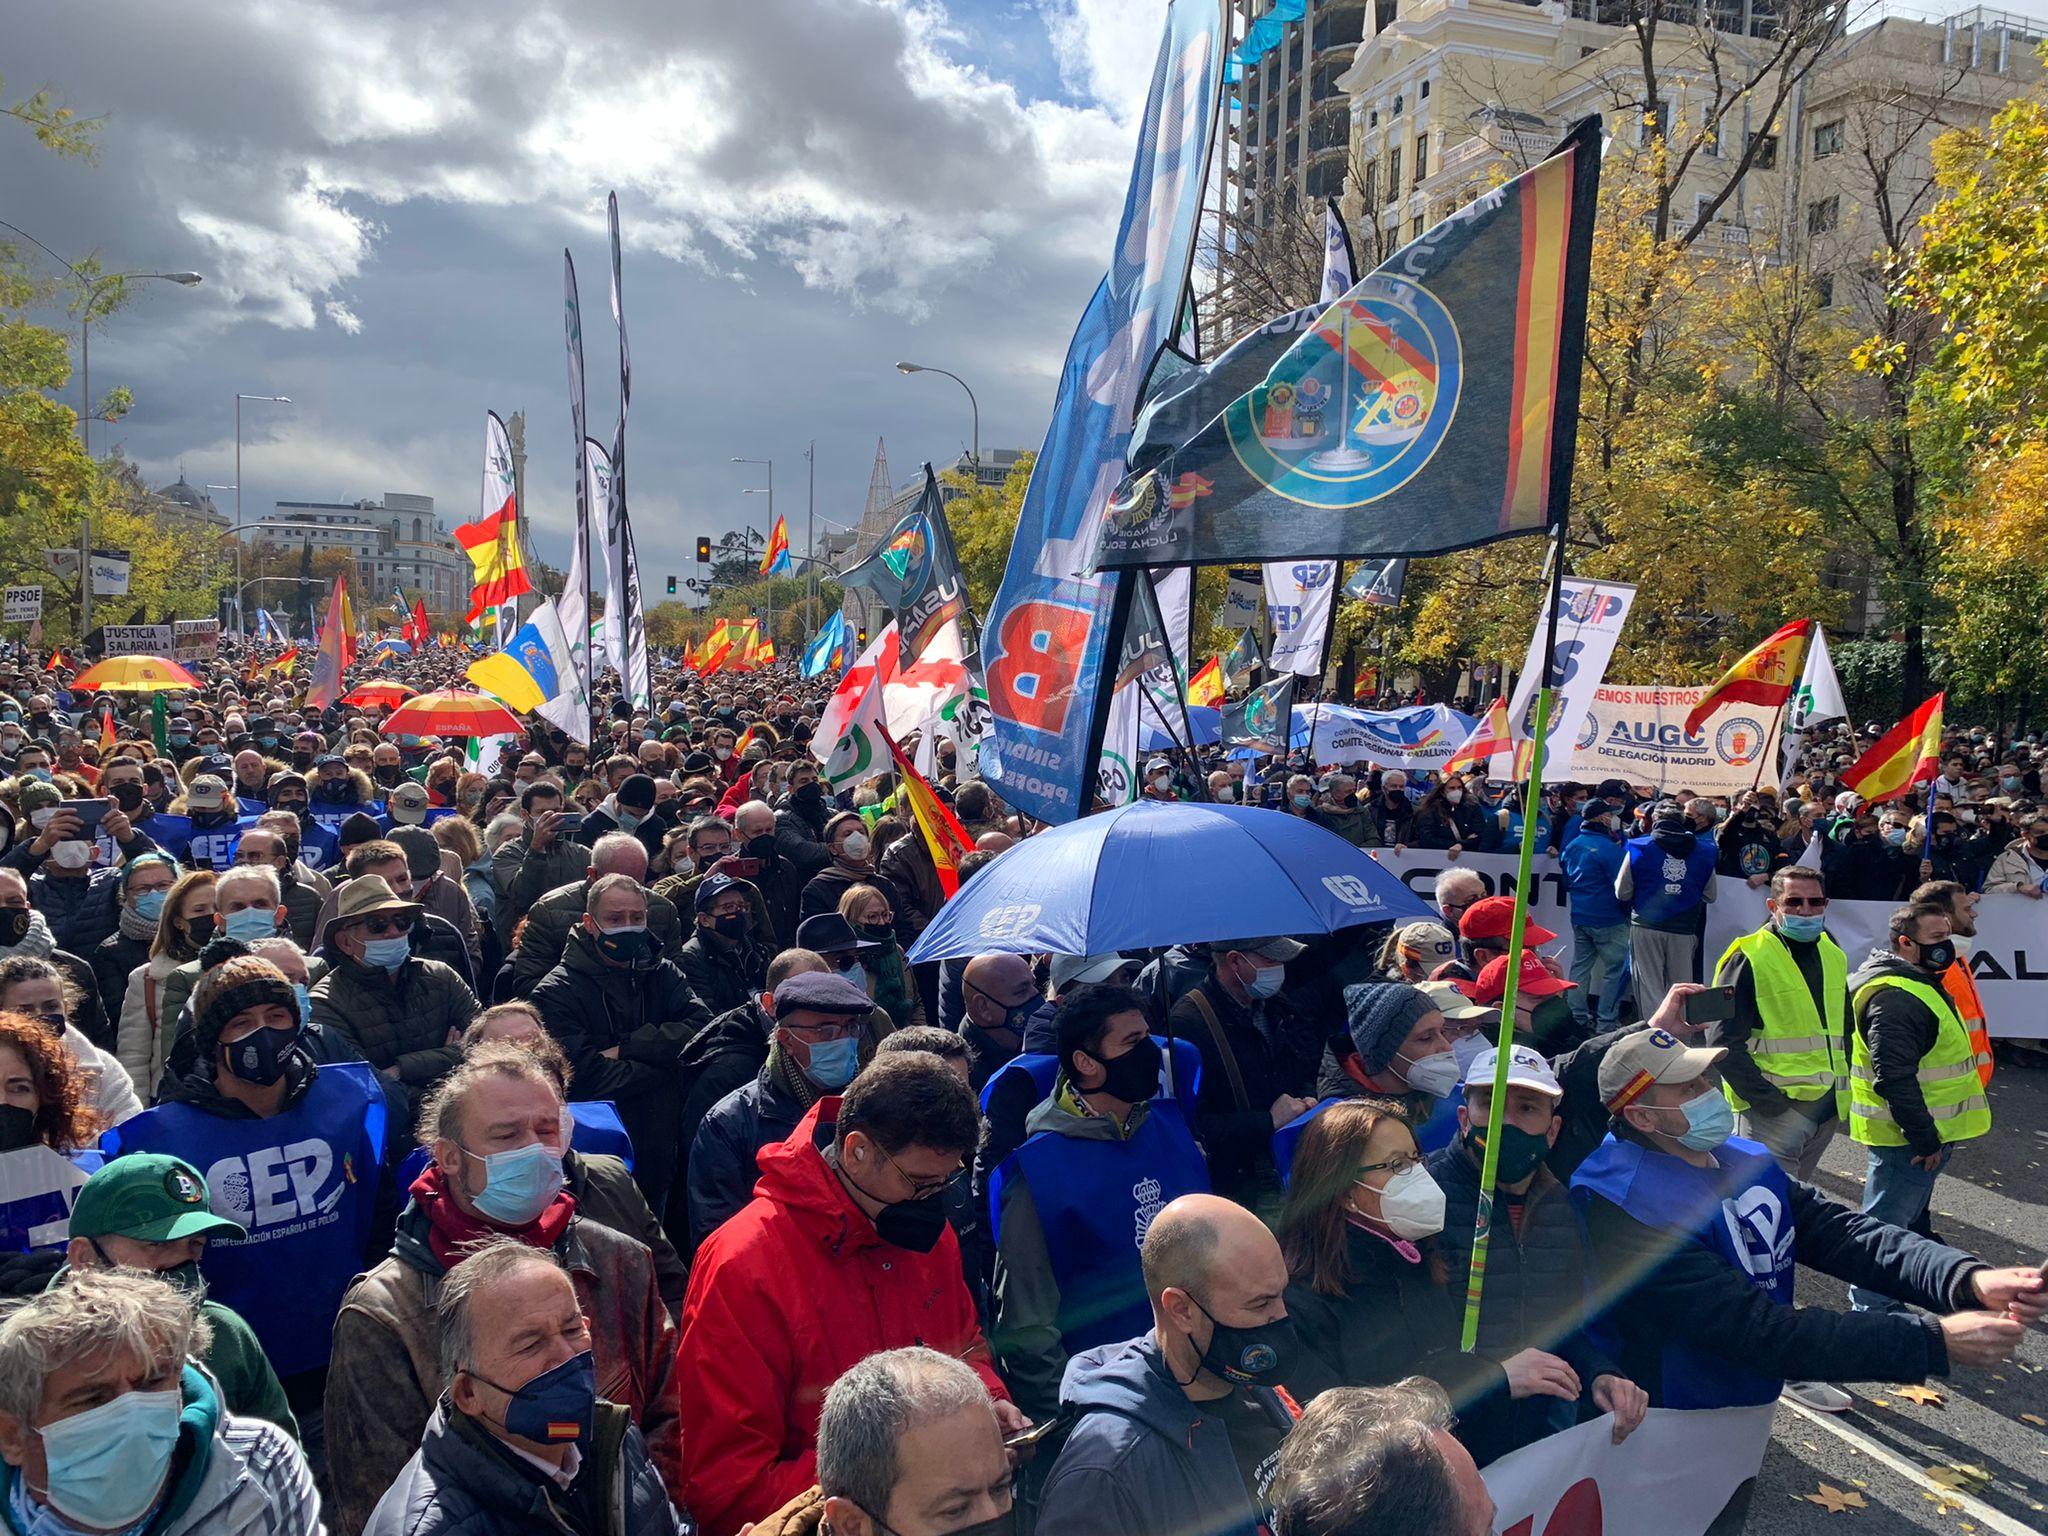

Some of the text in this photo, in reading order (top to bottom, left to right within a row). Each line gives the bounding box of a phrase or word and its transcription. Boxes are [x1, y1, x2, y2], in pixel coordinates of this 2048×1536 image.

[7, 589, 41, 603] PPSOE
[106, 627, 158, 639] JUSTICIA
[108, 640, 161, 652] SALARIAL
[1635, 690, 1700, 706] NUESTROS
[435, 722, 472, 731] ESPAÑA
[1610, 719, 1706, 747] AUGC
[1598, 746, 1716, 767] DELEGACIÓN MADRID
[1321, 874, 1373, 906] CEP
[175, 1175, 192, 1195] P
[205, 1138, 334, 1229] CEP
[272, 1222, 307, 1239] ESPAÑOLA
[307, 1219, 317, 1230] DE
